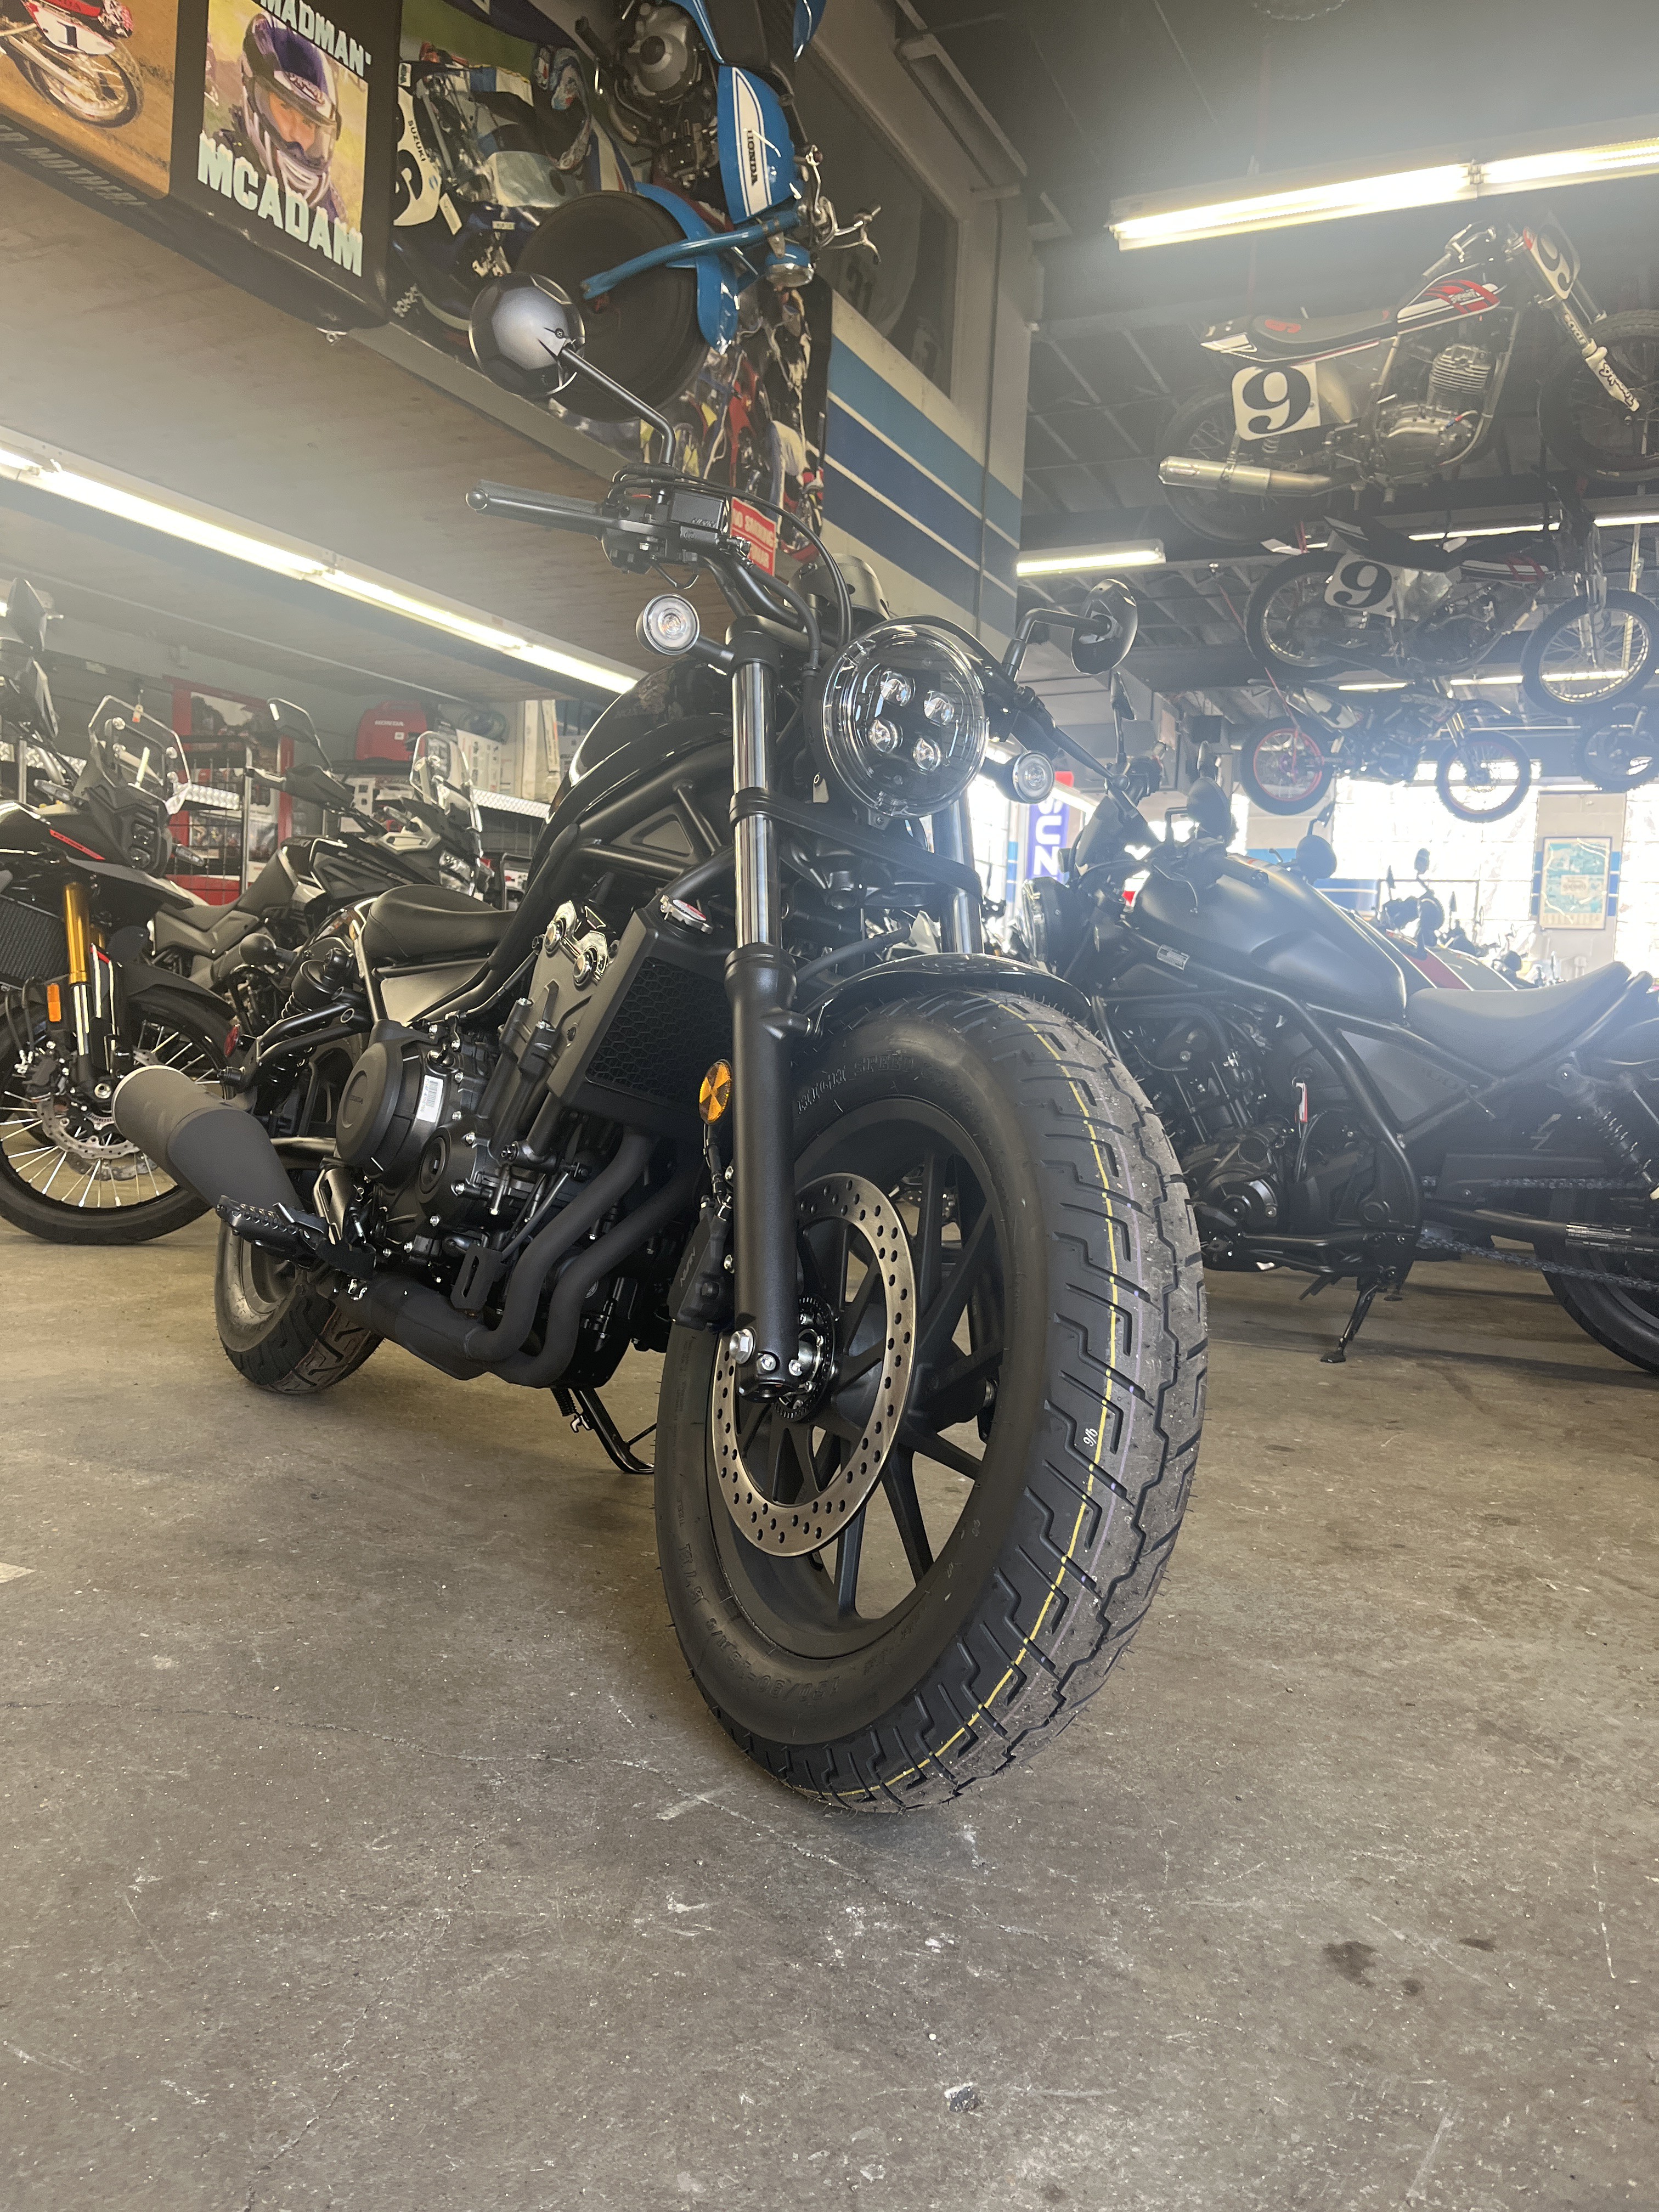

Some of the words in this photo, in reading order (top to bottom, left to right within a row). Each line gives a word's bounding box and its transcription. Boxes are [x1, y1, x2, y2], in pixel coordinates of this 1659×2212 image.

[408, 120, 426, 161] SUZUKI
[747, 130, 758, 185] HONDA
[198, 132, 363, 276] MCADAM
[1537, 225, 1574, 292] 9
[1242, 366, 1311, 434] 9
[1333, 560, 1392, 608] 9
